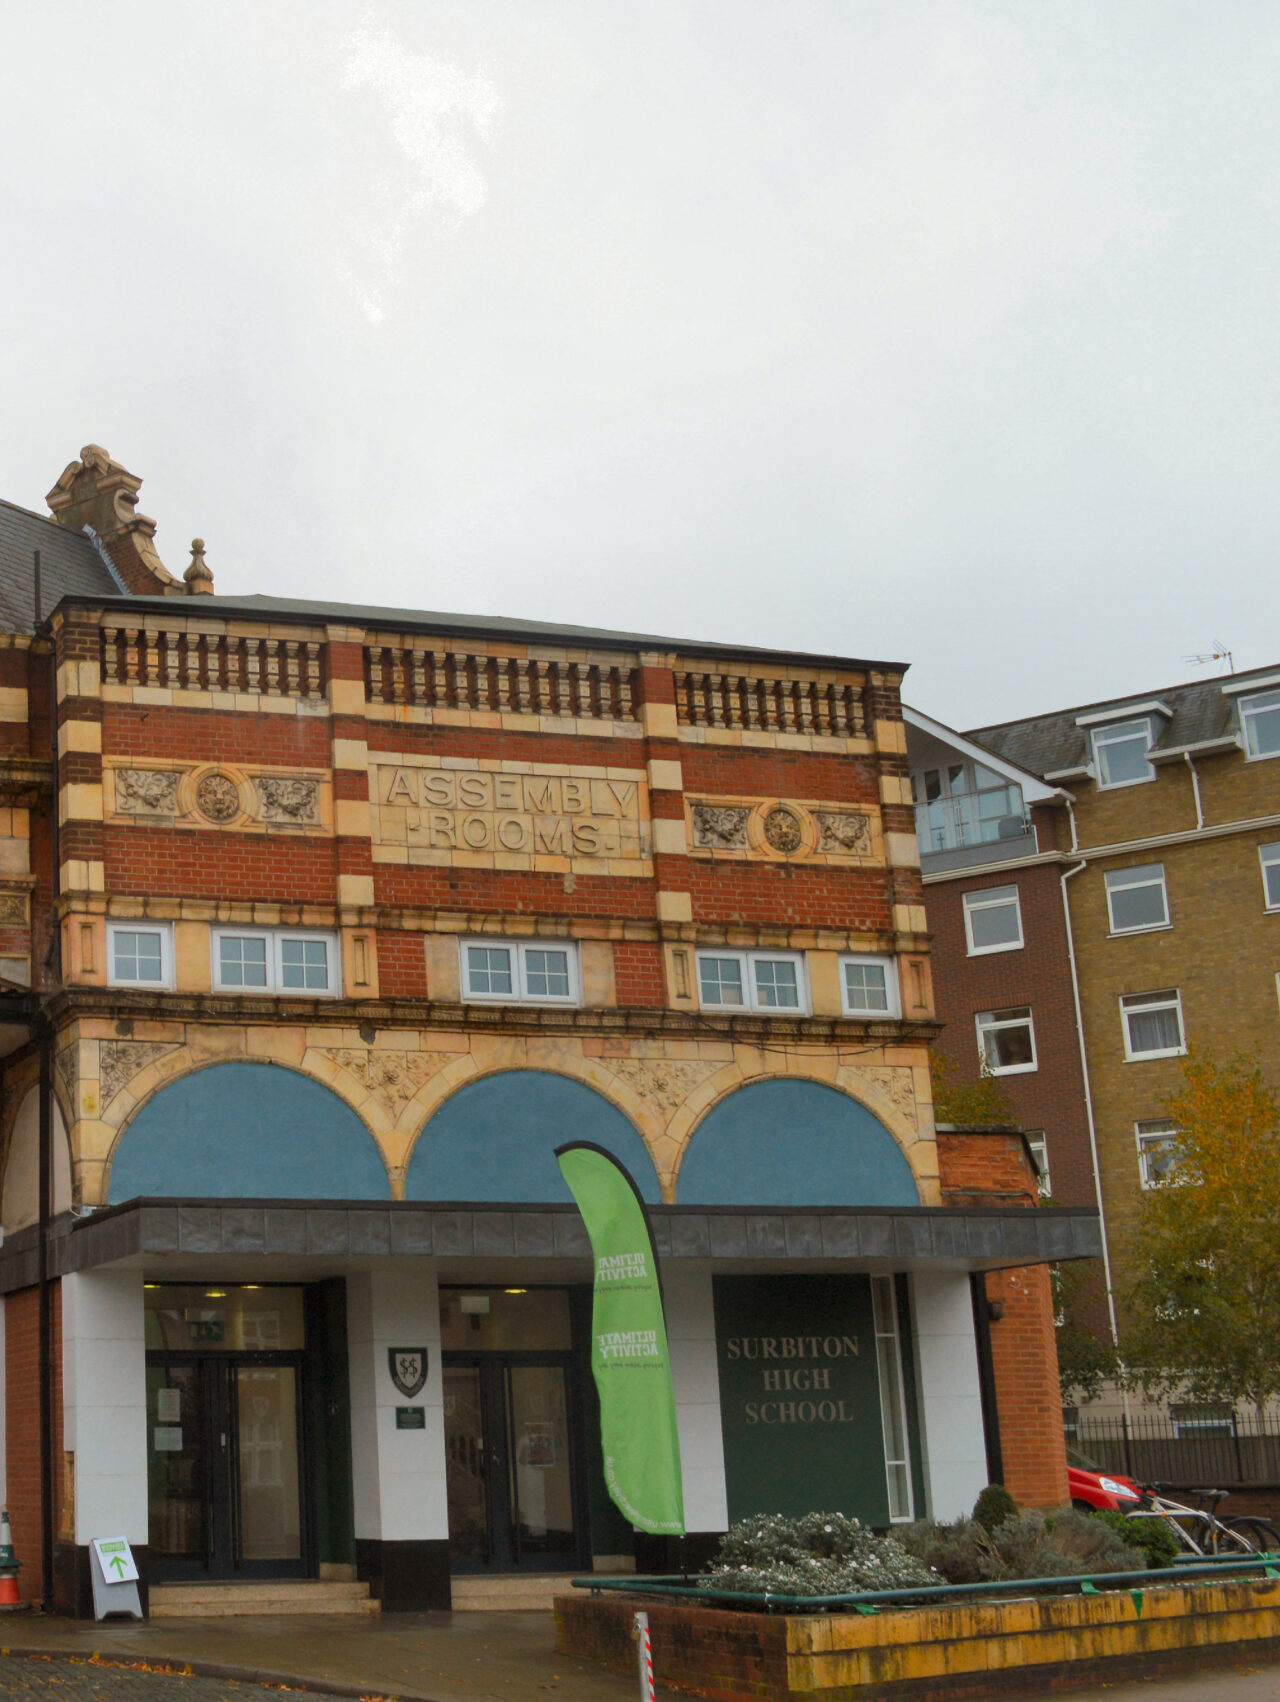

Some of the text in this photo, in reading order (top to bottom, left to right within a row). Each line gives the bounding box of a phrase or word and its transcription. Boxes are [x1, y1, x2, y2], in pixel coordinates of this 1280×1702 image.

[385, 768, 637, 818] ASSEMBLY
[727, 1335, 860, 1360] SURBITON
[762, 1367, 831, 1392] HIGH
[744, 1399, 855, 1425] SCHOOL
